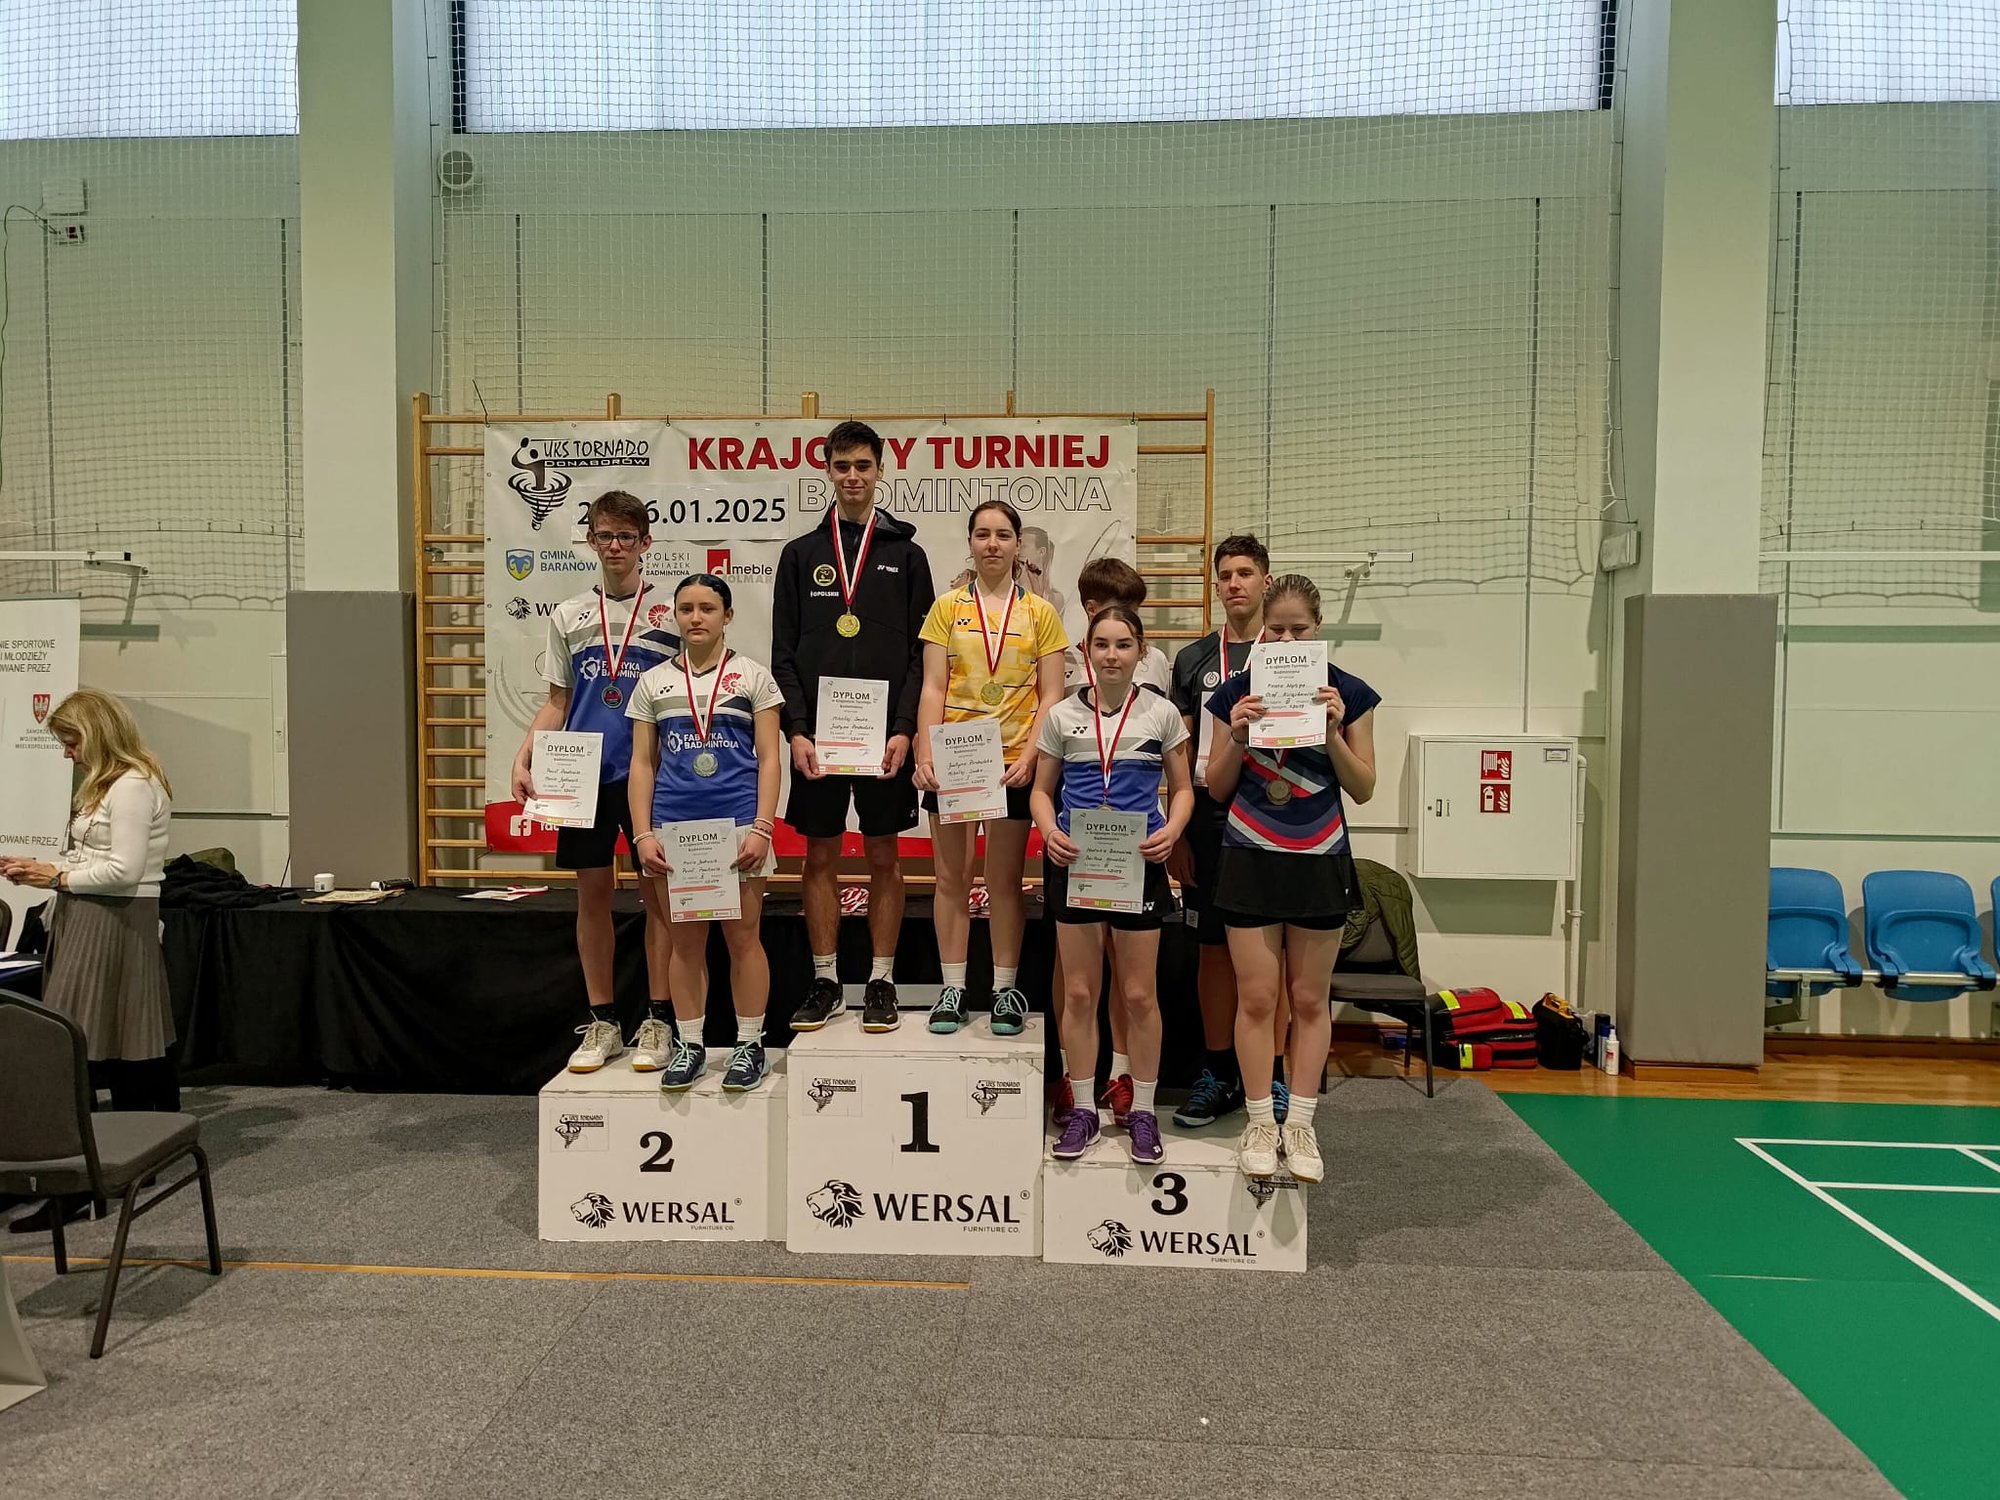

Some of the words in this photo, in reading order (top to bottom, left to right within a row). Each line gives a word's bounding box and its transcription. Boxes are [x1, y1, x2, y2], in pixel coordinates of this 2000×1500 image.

[543, 439, 570, 458] UKS
[573, 439, 649, 458] TORNADO
[688, 436, 917, 470] KRAJOY
[926, 434, 1110, 470] TURNIEJ
[544, 456, 648, 467] DONABORÓW
[540, 550, 576, 560] GMINA
[646, 552, 690, 561] POLSKI
[540, 560, 598, 572] BARANÓW
[732, 564, 773, 575] meble
[645, 569, 690, 577] BADMINTONA
[727, 574, 772, 584] OLMAR
[11, 639, 56, 649] SPORTOWE
[1266, 655, 1307, 665] DYPLOM
[27, 663, 52, 673] PRZEZ
[833, 691, 870, 701] DYPLOM
[945, 734, 983, 746] DYPLOM
[547, 744, 584, 753] DYPLOM
[1086, 823, 1127, 833] DYPLOM
[31, 836, 59, 847] PRZEZ
[679, 833, 718, 844] DYPLOM
[901, 1091, 940, 1153] 1
[639, 1131, 675, 1173] 2
[1151, 1172, 1189, 1215] 3
[622, 1201, 735, 1223] WERSAL
[873, 1192, 1021, 1224] WERSAL
[1140, 1230, 1257, 1257] WERSAL
